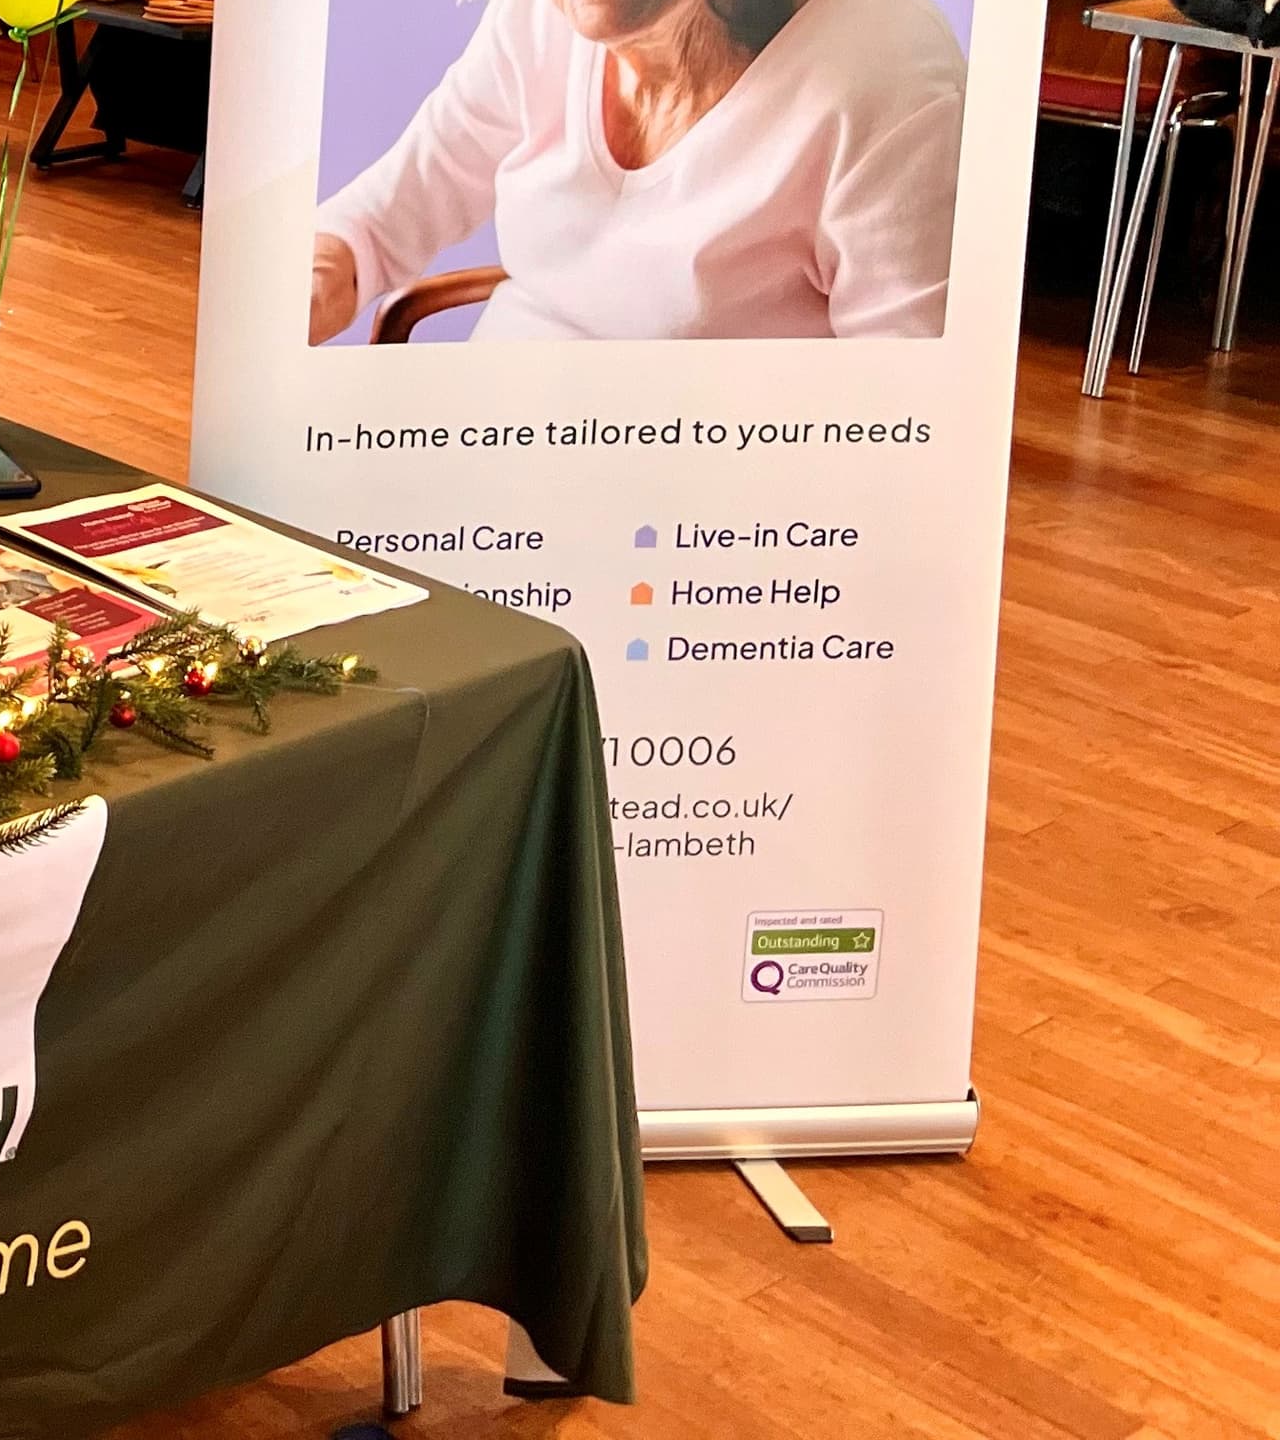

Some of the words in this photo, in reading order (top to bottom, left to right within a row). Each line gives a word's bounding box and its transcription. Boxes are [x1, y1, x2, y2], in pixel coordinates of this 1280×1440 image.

[306, 424, 449, 452] In-home
[460, 423, 534, 447] care
[546, 418, 681, 446] tailored
[693, 420, 727, 445] to
[737, 421, 815, 451] your
[823, 416, 932, 445] needs
[337, 526, 464, 553] Personal
[472, 525, 544, 551] Care
[676, 522, 778, 548] Live-in
[786, 522, 858, 547] Care
[671, 580, 762, 605] Home
[771, 578, 840, 609] Help
[667, 635, 814, 661] Dementia
[822, 634, 894, 660] Care
[630, 735, 736, 767] 0006
[609, 792, 793, 821] tead.co.uk/
[754, 916, 798, 927] Inspected
[800, 916, 817, 925] and
[820, 915, 843, 924] rated
[757, 933, 840, 951] Outstanding
[786, 975, 865, 988] Commission
[788, 963, 818, 975] Care
[820, 961, 869, 976] Quality
